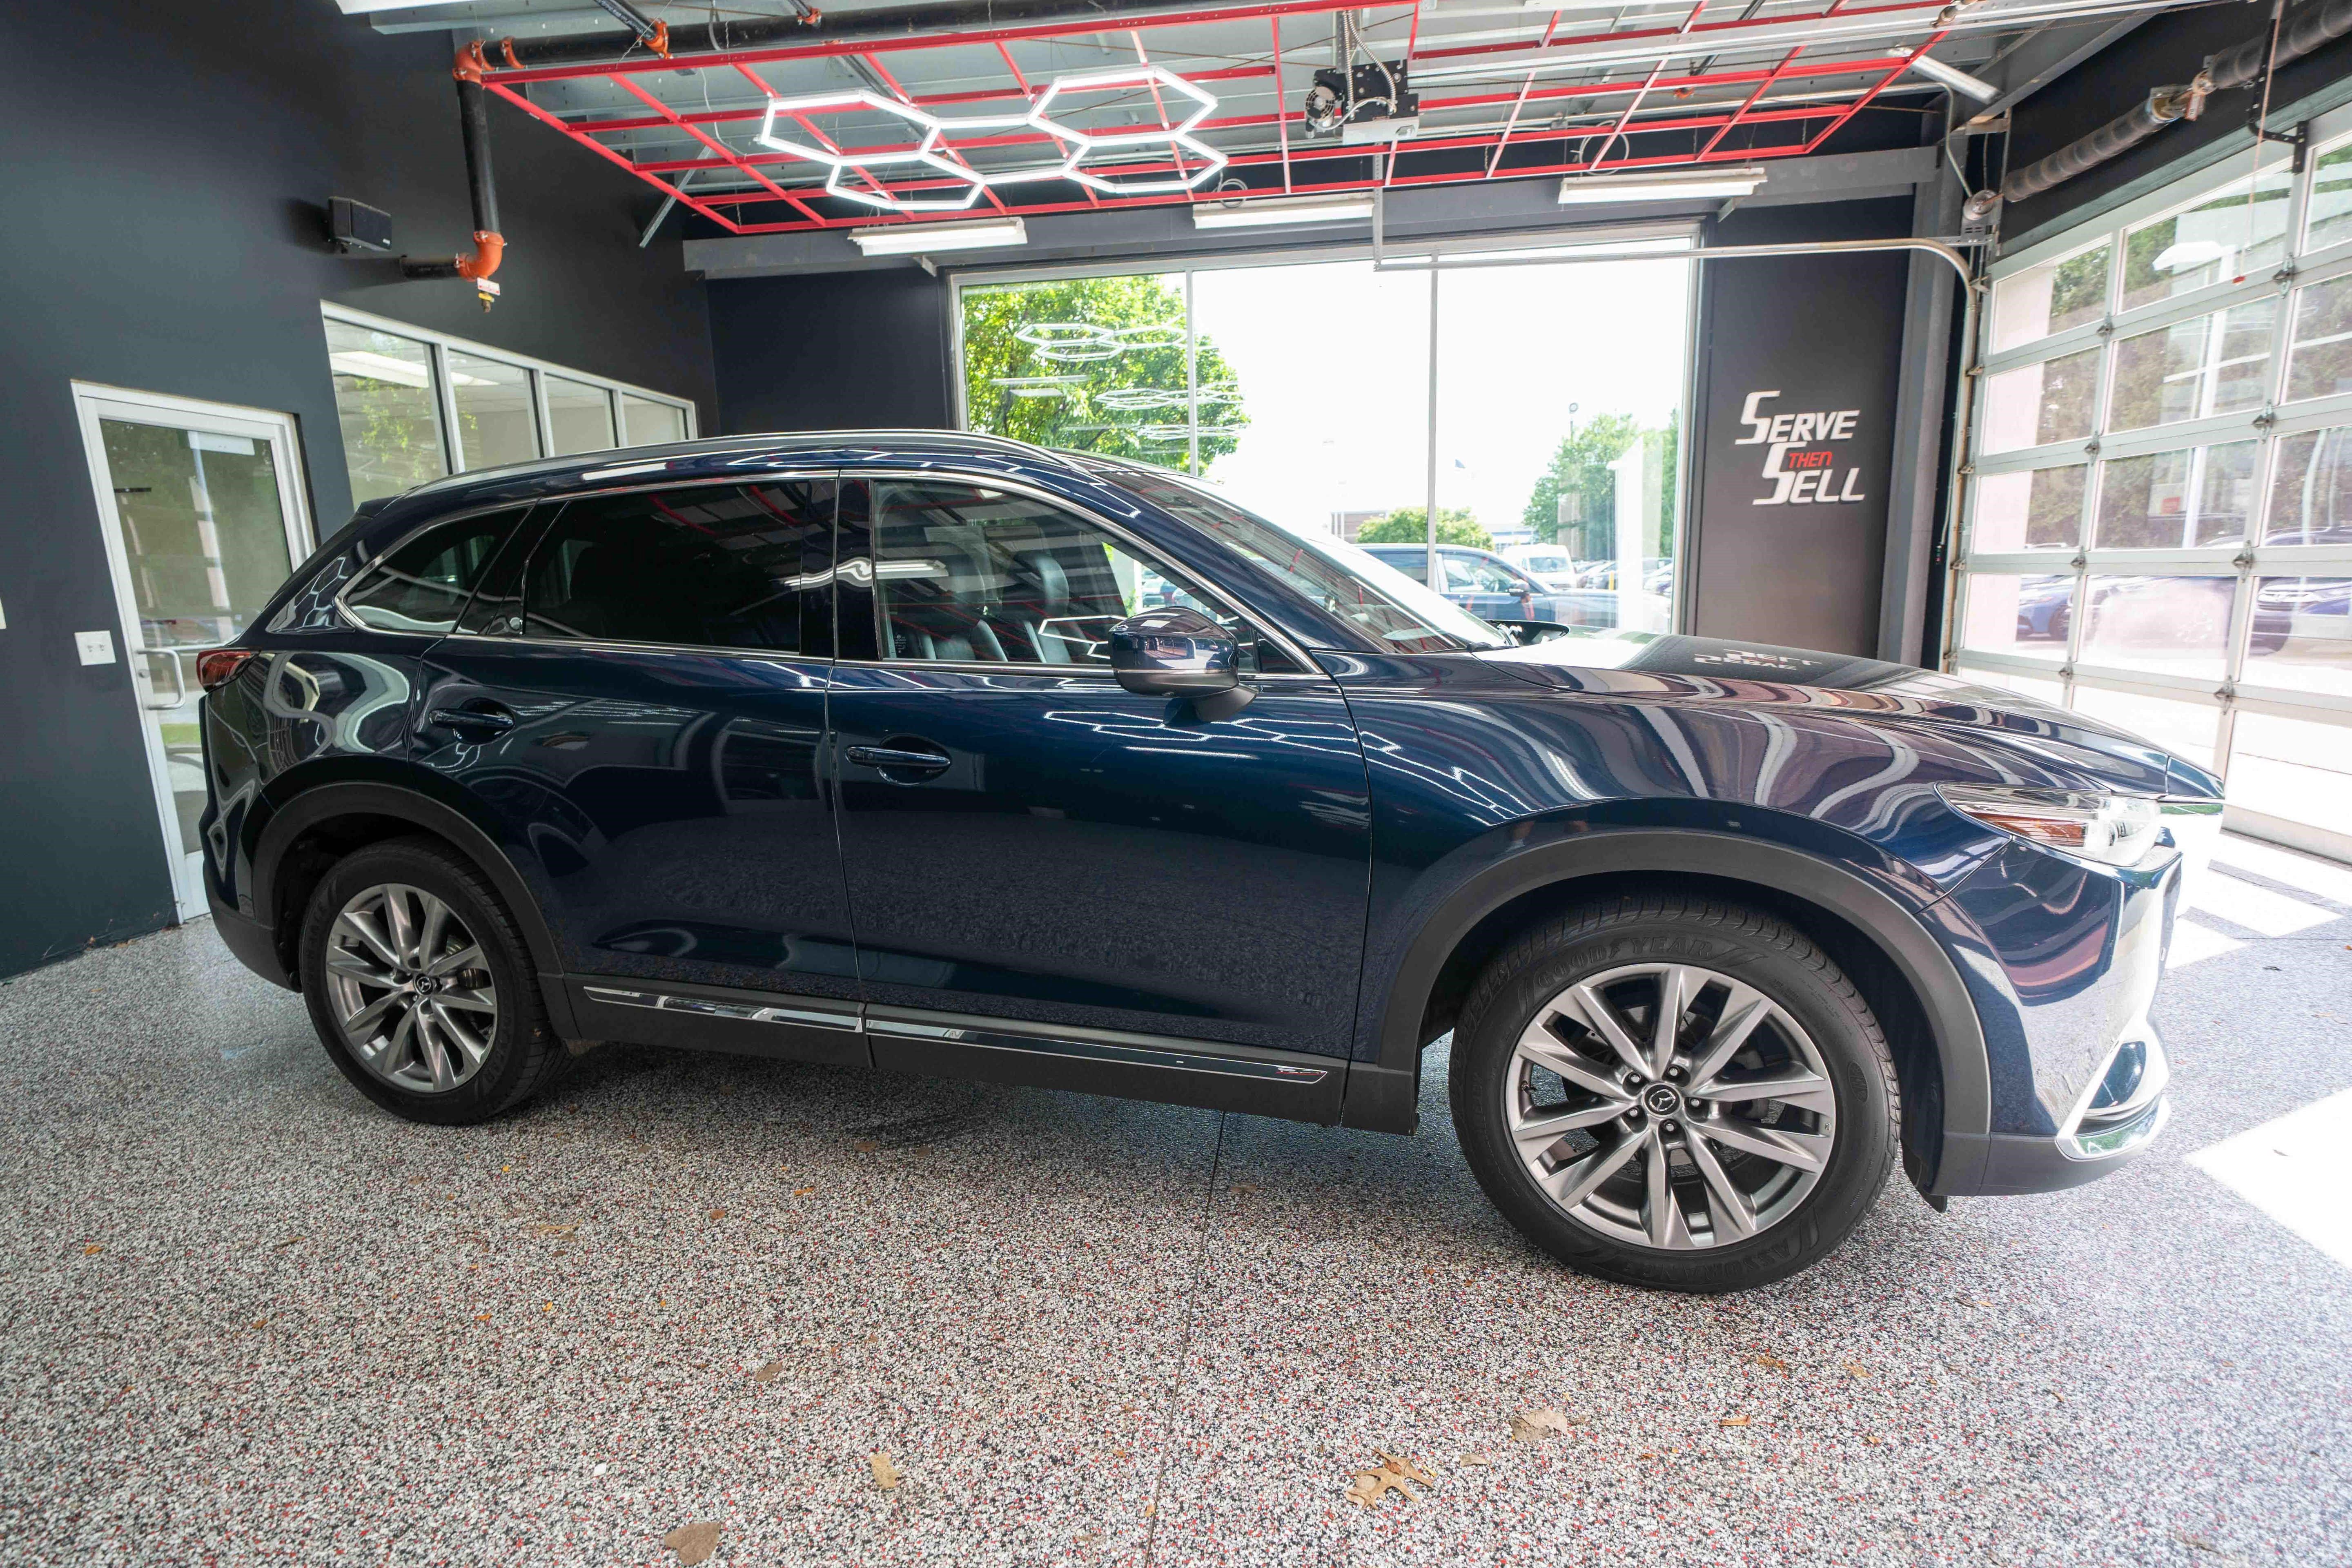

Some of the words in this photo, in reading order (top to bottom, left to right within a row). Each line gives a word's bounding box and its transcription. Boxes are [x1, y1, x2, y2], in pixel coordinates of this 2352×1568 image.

[1735, 390, 1860, 445] SERVE
[1752, 441, 1866, 505] SELL
[1788, 451, 1834, 468] THEN
